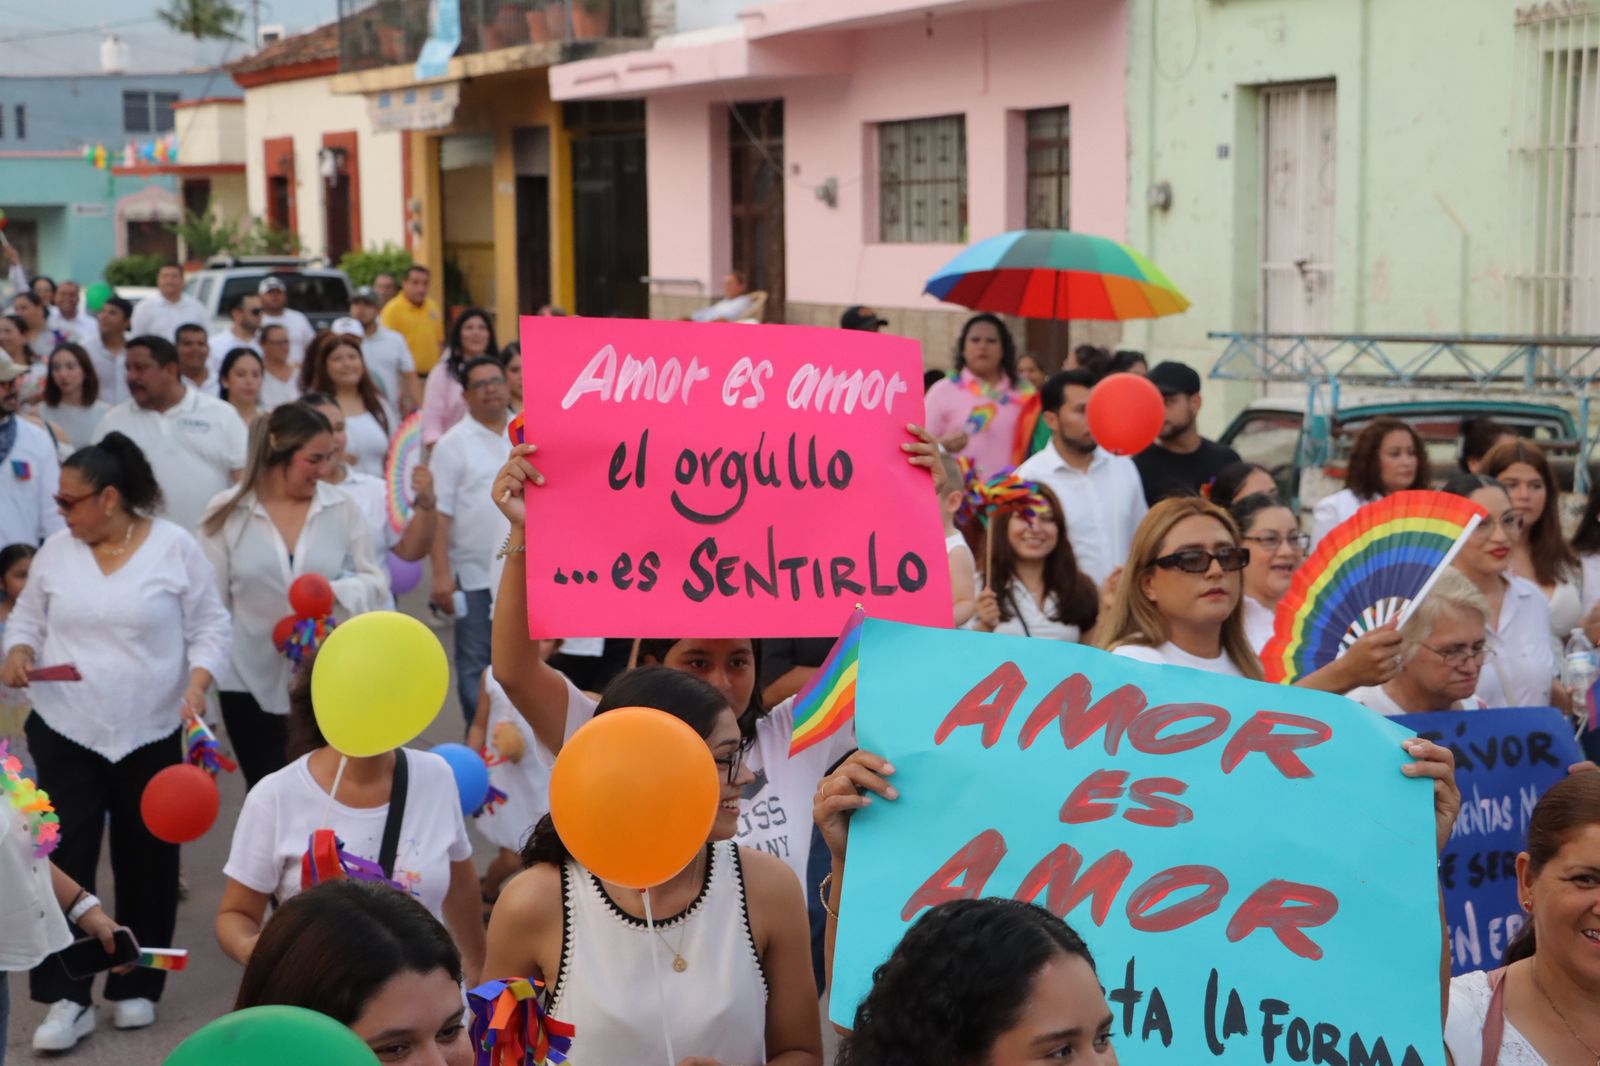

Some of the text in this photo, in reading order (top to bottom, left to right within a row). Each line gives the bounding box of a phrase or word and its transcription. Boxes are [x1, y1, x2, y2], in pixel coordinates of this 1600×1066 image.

[561, 343, 908, 415] Amor es amor
[607, 428, 650, 491] el
[682, 524, 929, 602] SENTIRLO
[933, 660, 1334, 780] AMOR
[1058, 768, 1195, 829] ES
[900, 828, 1340, 962] AMOR
